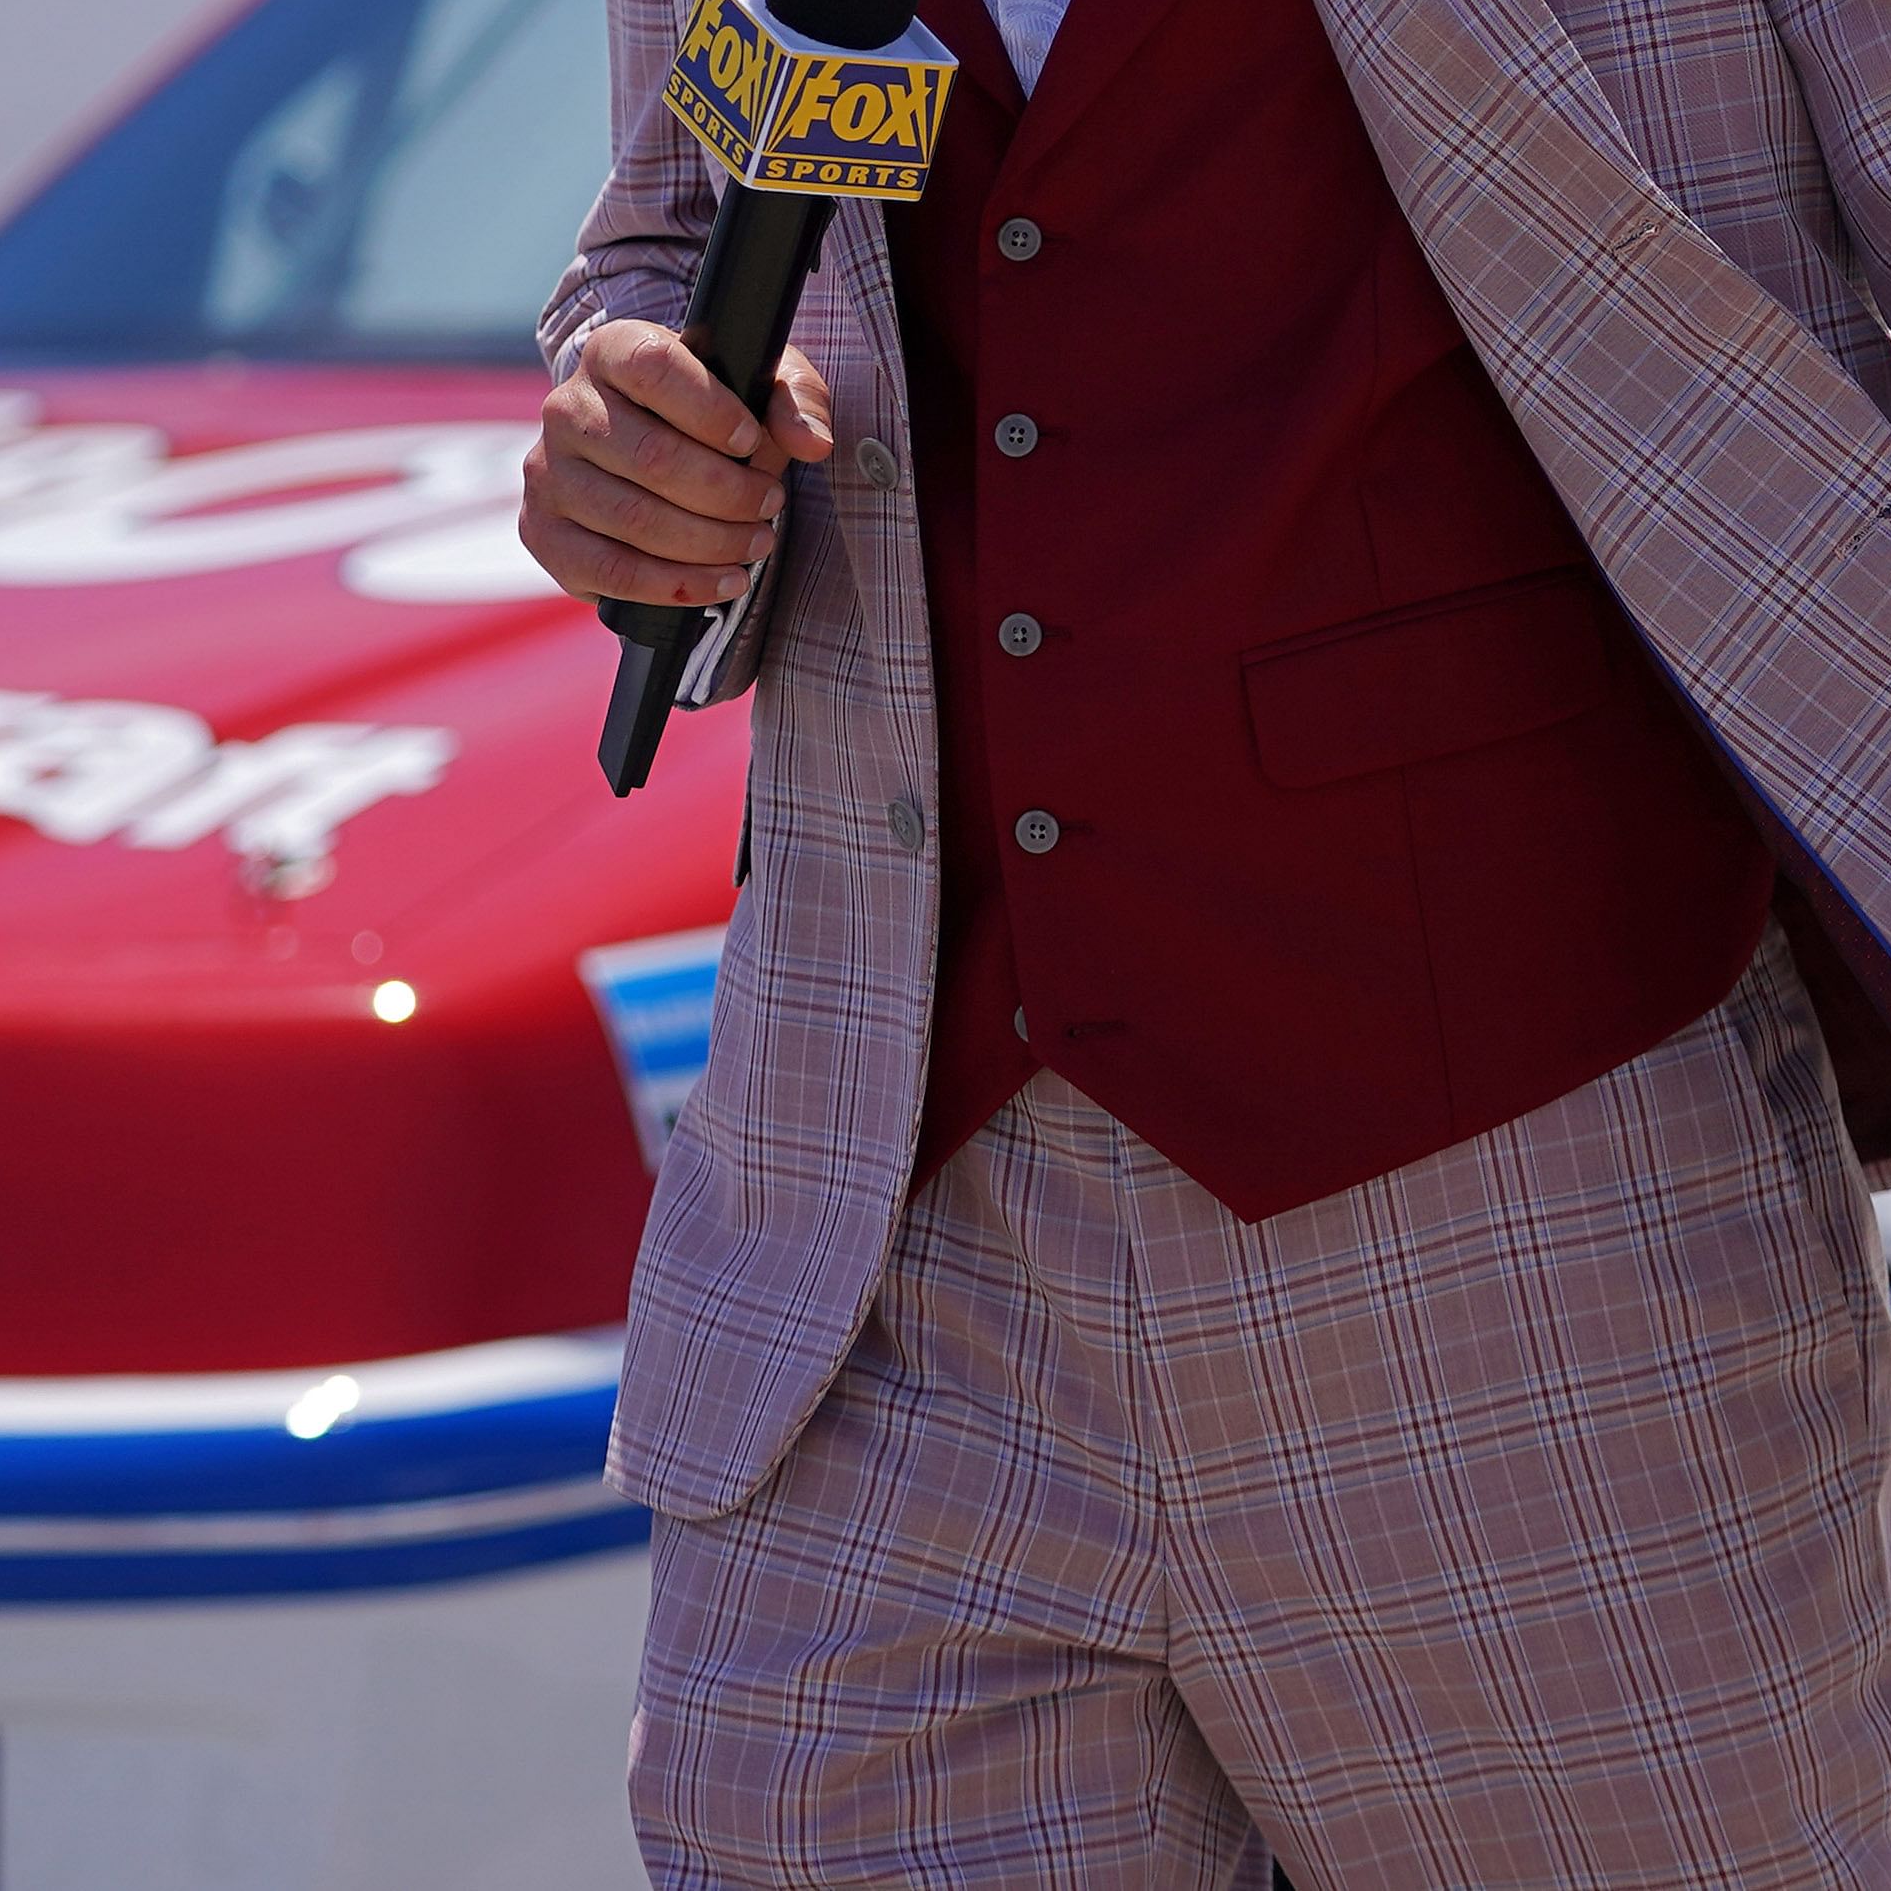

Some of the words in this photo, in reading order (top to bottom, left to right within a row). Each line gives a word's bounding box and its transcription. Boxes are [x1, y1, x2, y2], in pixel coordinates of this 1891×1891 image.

[668, 73, 745, 166] SPORTS
[788, 77, 932, 147] FOX
[765, 159, 919, 189] SPORTS
